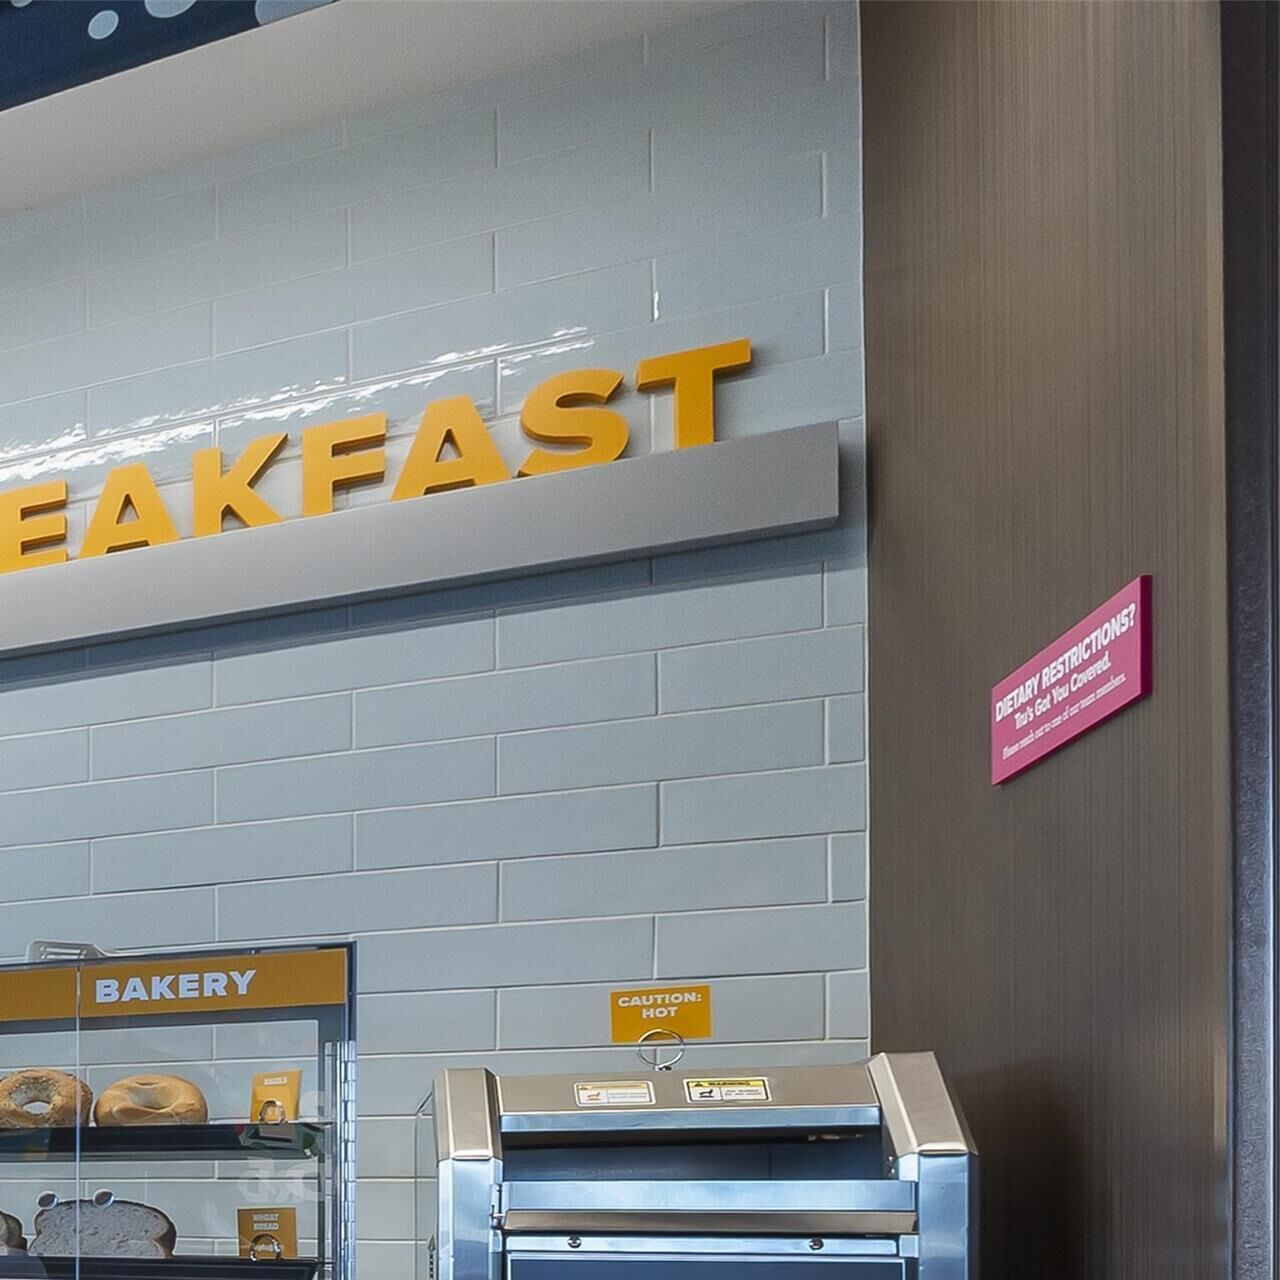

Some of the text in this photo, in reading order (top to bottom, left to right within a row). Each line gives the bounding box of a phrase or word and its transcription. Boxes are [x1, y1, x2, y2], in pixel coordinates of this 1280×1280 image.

[995, 603, 1136, 722] DIETARY RESTRICTIONS?
[1035, 693, 1052, 716] Got
[1052, 684, 1069, 705] You
[1070, 650, 1112, 692] Covered.
[95, 969, 257, 1004] BAKERY
[618, 992, 702, 1007] CAUTION:
[642, 1006, 679, 1018] HOT
